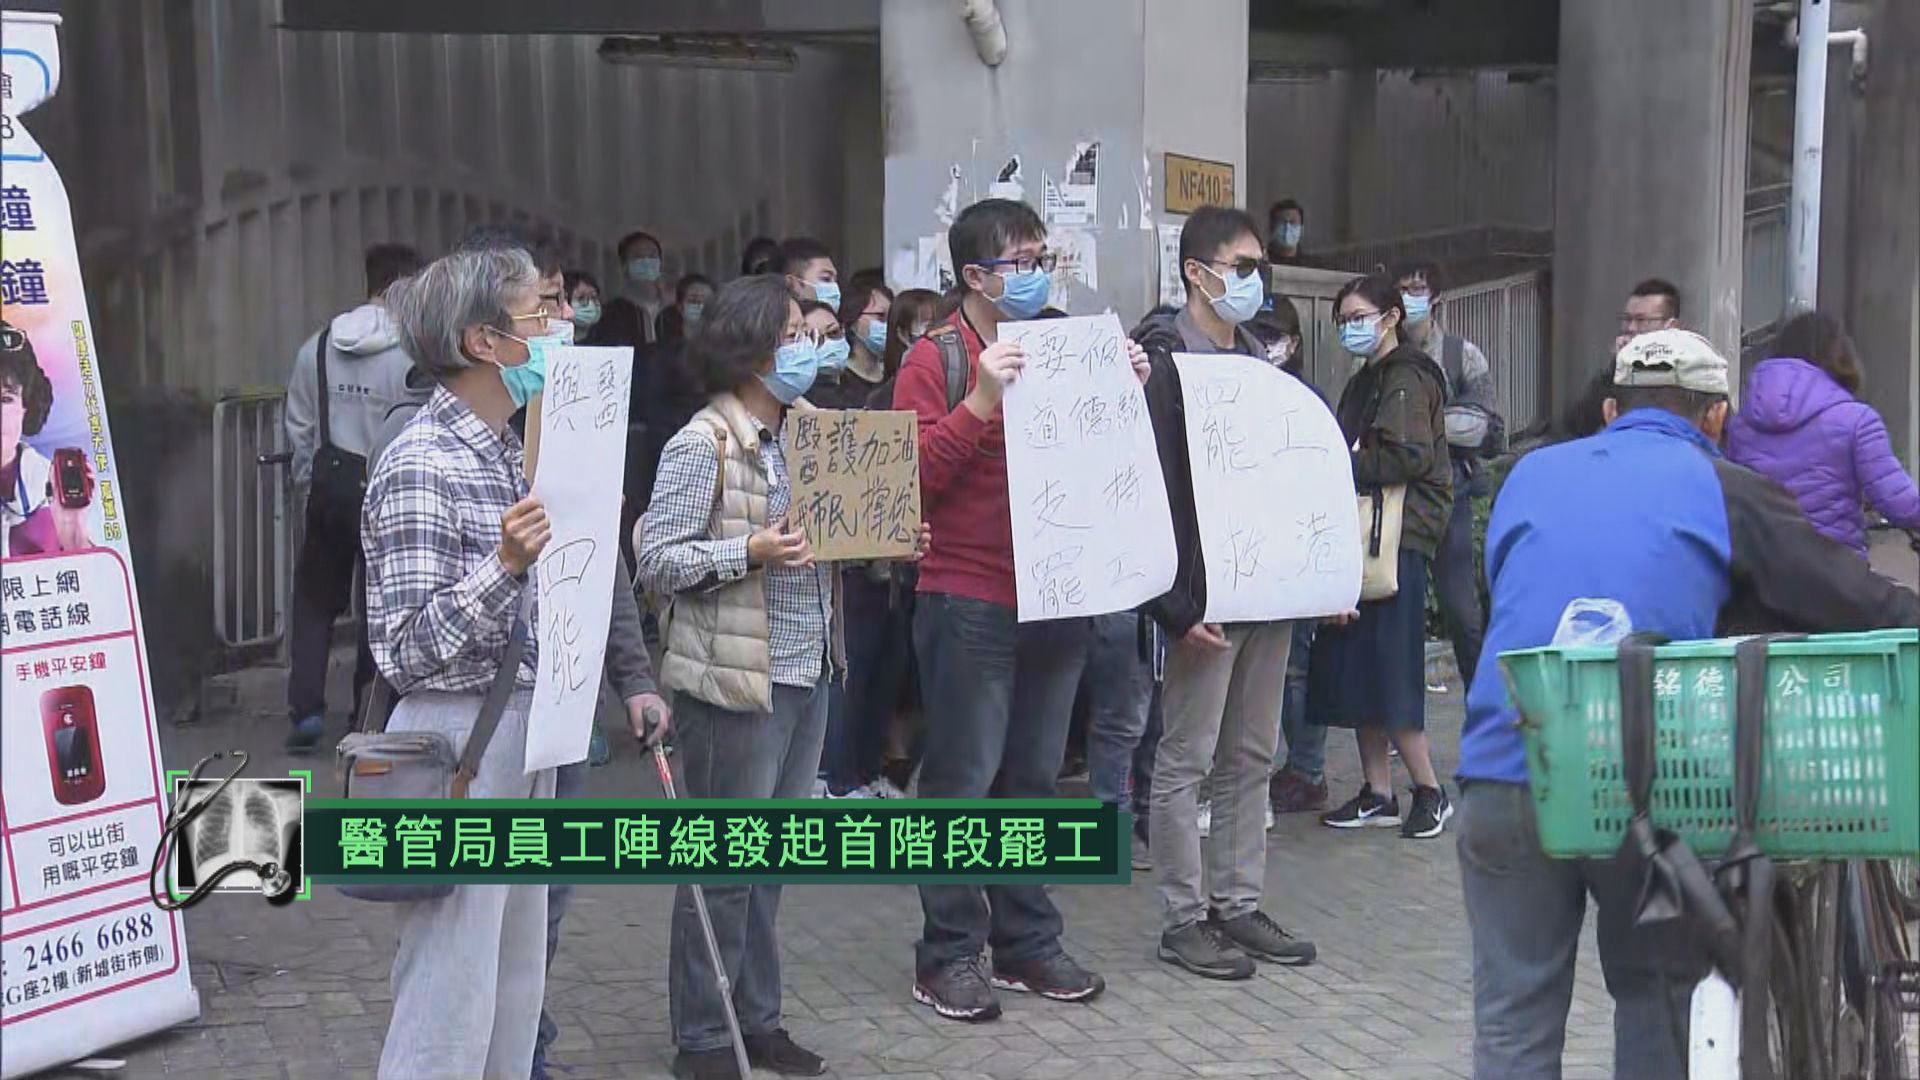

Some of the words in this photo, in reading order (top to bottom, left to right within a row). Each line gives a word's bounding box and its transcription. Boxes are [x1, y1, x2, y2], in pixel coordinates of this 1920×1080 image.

[1179, 170, 1220, 203] NF410
[1192, 376, 1329, 473] 罷工
[16, 652, 107, 681] 手機平安鐘
[48, 822, 125, 857] 可以出街
[43, 846, 139, 889] 用嘅平安鐘
[24, 930, 84, 972] 2466
[97, 912, 153, 950] 6688
